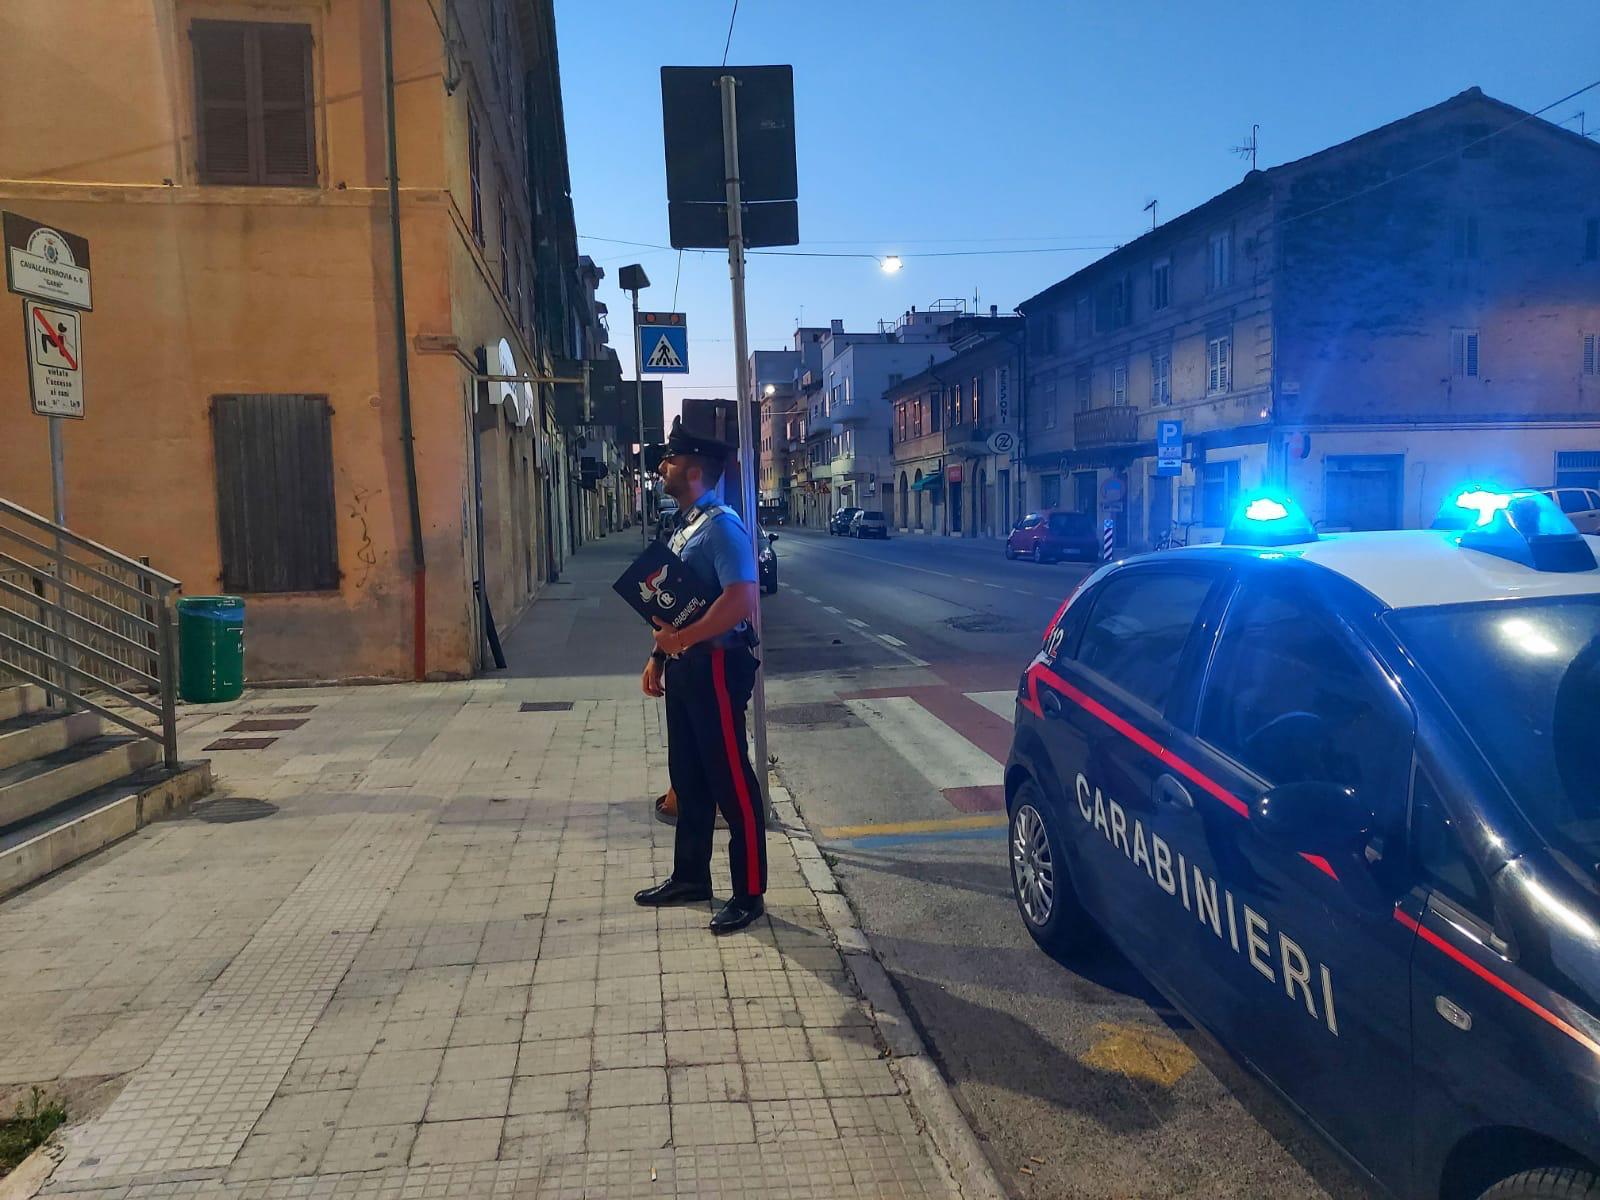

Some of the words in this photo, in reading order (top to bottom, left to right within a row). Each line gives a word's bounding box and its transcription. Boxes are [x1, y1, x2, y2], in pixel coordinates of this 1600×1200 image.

[1163, 423, 1178, 444] P
[672, 597, 700, 628] ARABINIERI
[1076, 772, 1338, 1037] CARABINIERI
